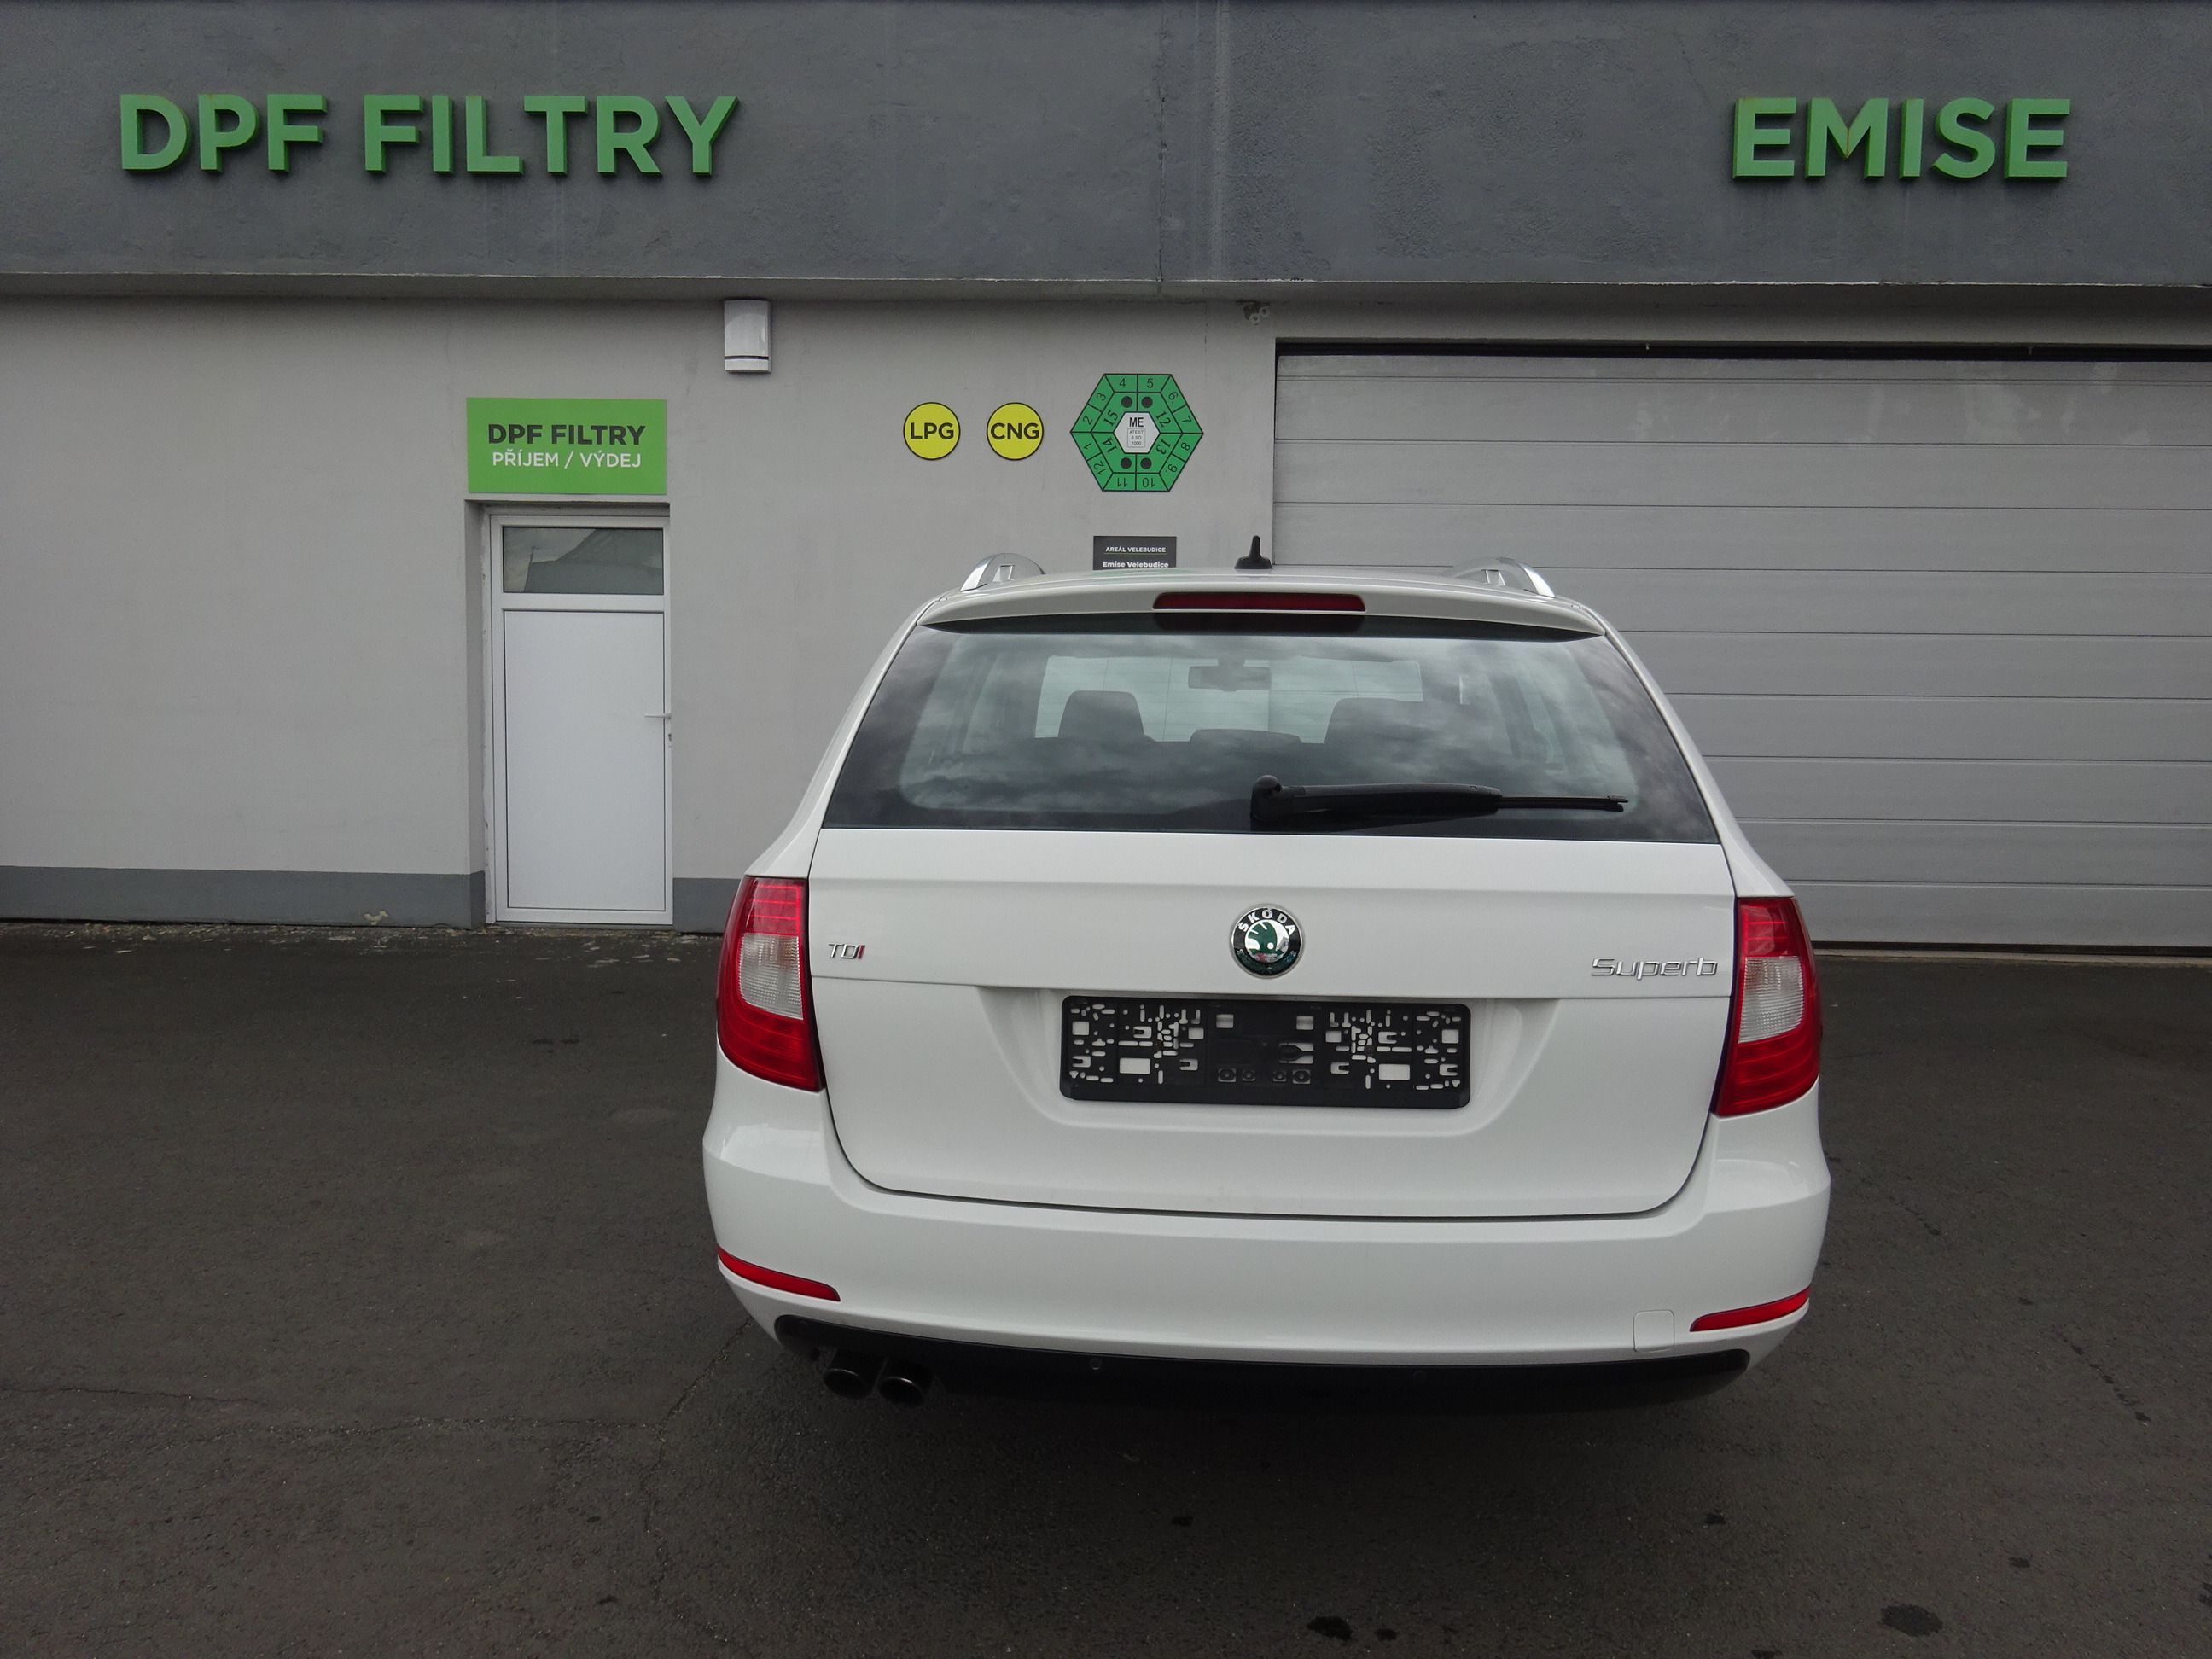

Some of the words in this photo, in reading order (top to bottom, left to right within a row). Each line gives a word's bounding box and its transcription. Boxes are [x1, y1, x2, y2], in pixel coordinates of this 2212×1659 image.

[120, 94, 328, 174] DPF
[364, 95, 739, 176] FILTRY
[1732, 96, 2071, 179] EMISE
[1119, 378, 1126, 387] 4
[1146, 378, 1154, 388] 5
[1096, 392, 1107, 401] 3
[1082, 416, 1093, 426] 2
[1103, 410, 1119, 426] 15
[1129, 416, 1144, 428] ME
[1156, 410, 1172, 427] 12
[1181, 416, 1192, 425] 7
[488, 423, 543, 445] DPF
[551, 424, 646, 445] FILTRY
[910, 422, 954, 439] LPG
[990, 422, 1040, 440] CNG
[1102, 437, 1117, 452] 14
[1156, 439, 1171, 455] 13
[1180, 442, 1190, 451] 8
[492, 448, 559, 467] PŘÍJEM
[564, 451, 574, 469] /
[580, 450, 642, 469] VÝDEJ
[1117, 477, 1127, 486] 11
[1142, 477, 1155, 487] 10
[1126, 560, 1169, 568] Velebudice
[828, 943, 866, 960] TDI
[1592, 957, 1718, 981] Superb
